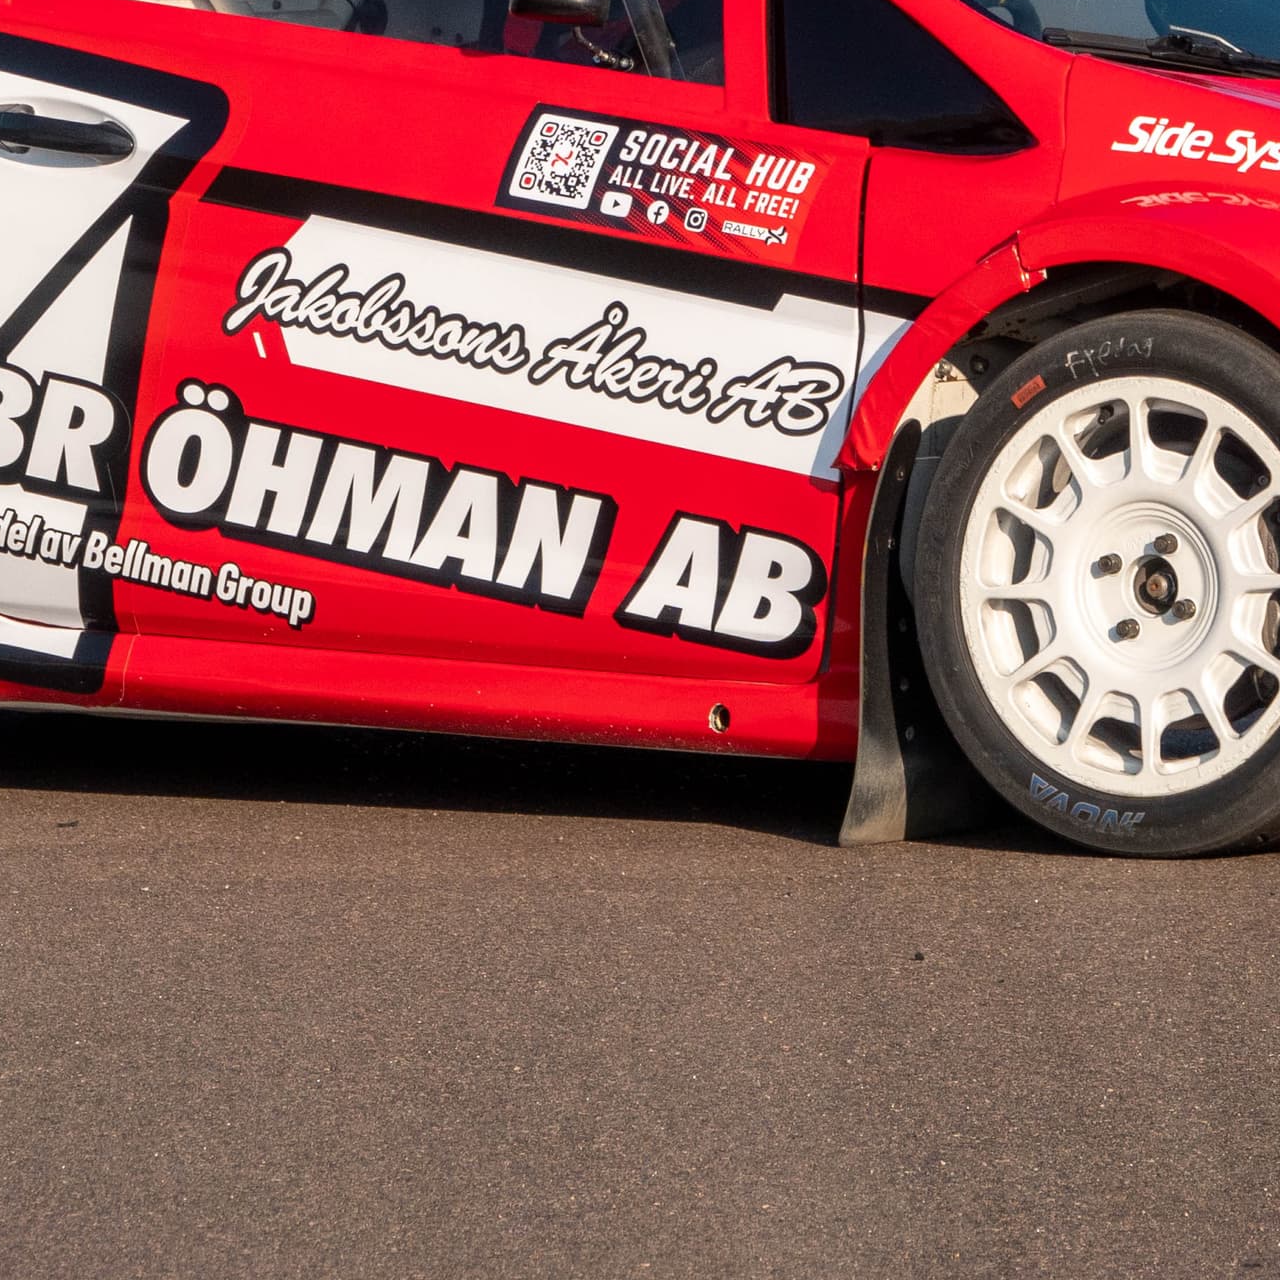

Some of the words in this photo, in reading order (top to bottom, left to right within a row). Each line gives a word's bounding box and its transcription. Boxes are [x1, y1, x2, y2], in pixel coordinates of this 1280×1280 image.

[620, 130, 735, 180] SOCIAL
[744, 154, 816, 195] HUB
[1111, 116, 1213, 160] Side
[608, 165, 644, 189] ALL
[650, 172, 695, 200] LIVE.
[701, 183, 738, 208] ALL
[742, 191, 800, 220] FREE!
[225, 249, 525, 370] Jakobssons
[531, 306, 710, 407] Åkeri
[712, 362, 840, 432] AB
[139, 382, 604, 601] ÖHMAN
[625, 519, 815, 643] AB
[40, 532, 82, 565] av
[83, 531, 212, 596] Bellman
[216, 563, 314, 626] Group
